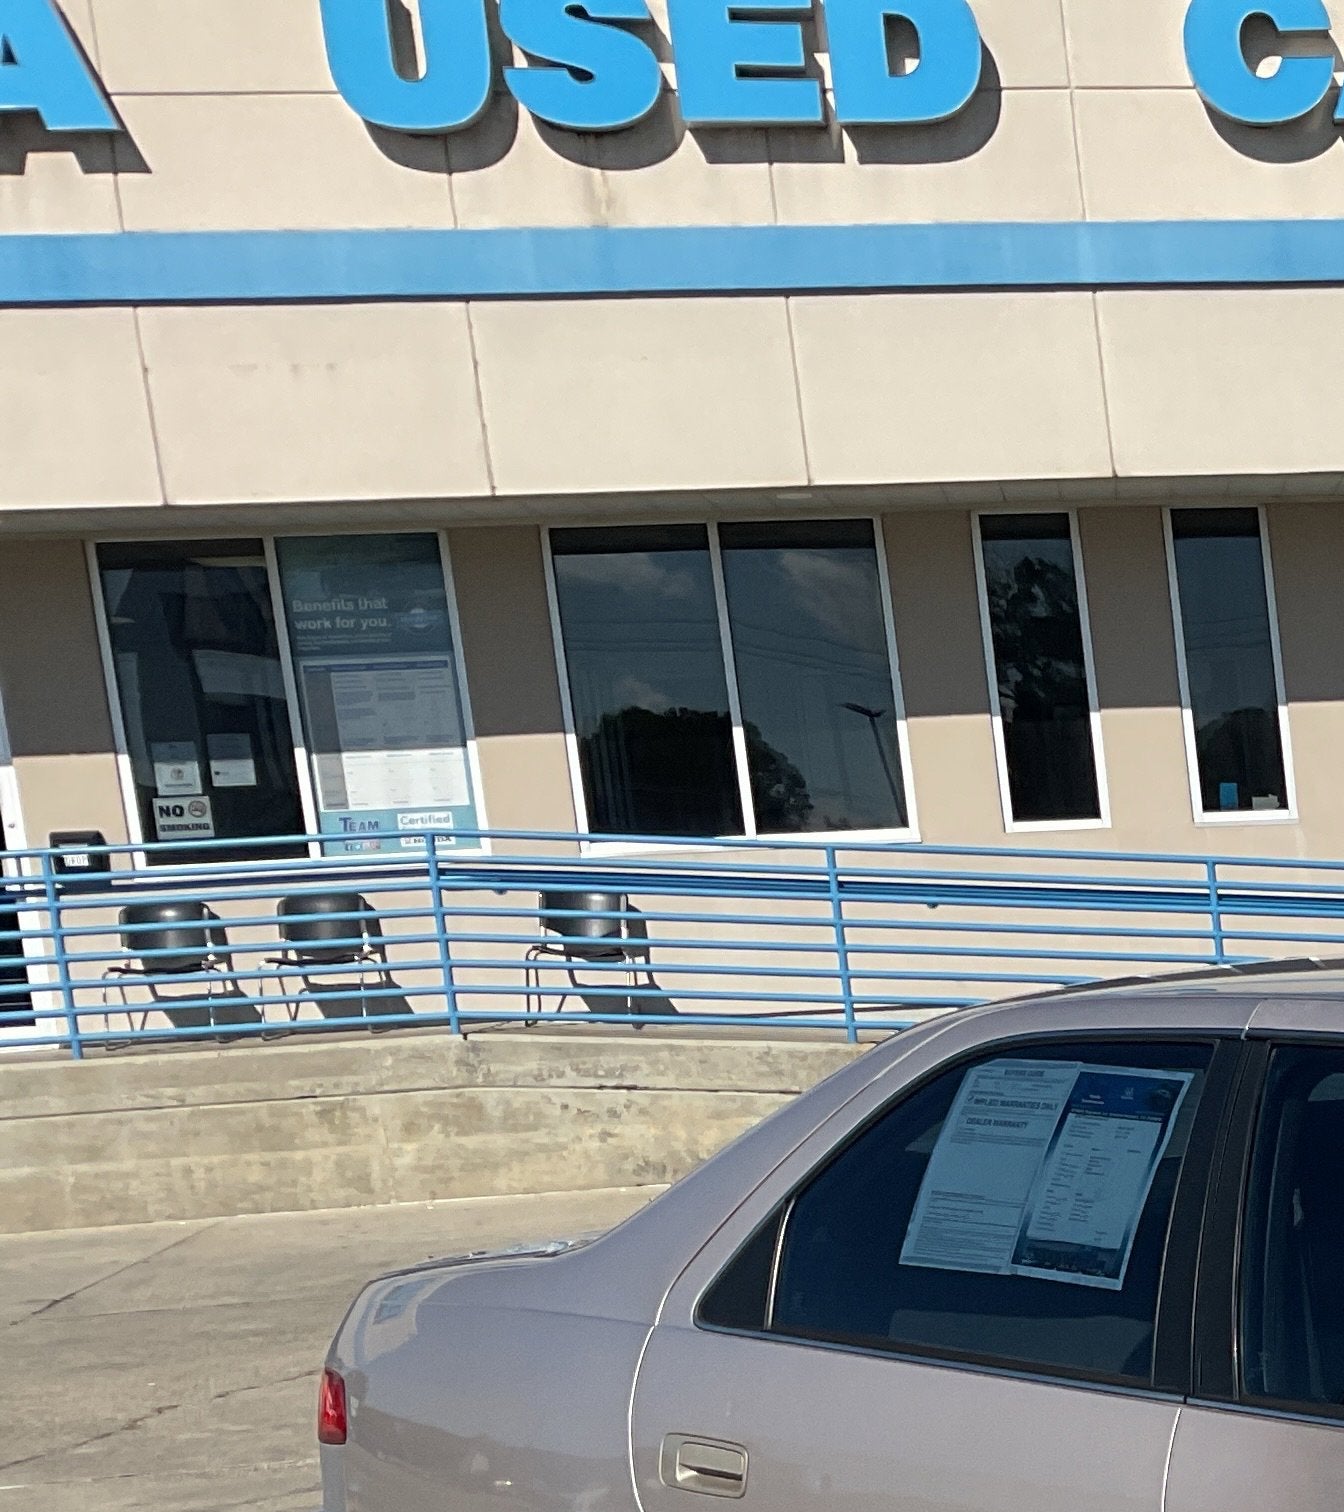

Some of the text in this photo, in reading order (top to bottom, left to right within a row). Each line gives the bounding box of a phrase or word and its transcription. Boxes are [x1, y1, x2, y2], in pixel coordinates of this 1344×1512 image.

[322, 0, 983, 131] USED
[292, 598, 388, 613] Benefits that
[294, 617, 332, 630] work
[336, 617, 356, 629] for
[158, 804, 185, 818] NO
[159, 822, 210, 833] SMOKING
[338, 816, 380, 832] TEAM
[400, 815, 451, 826] Certified
